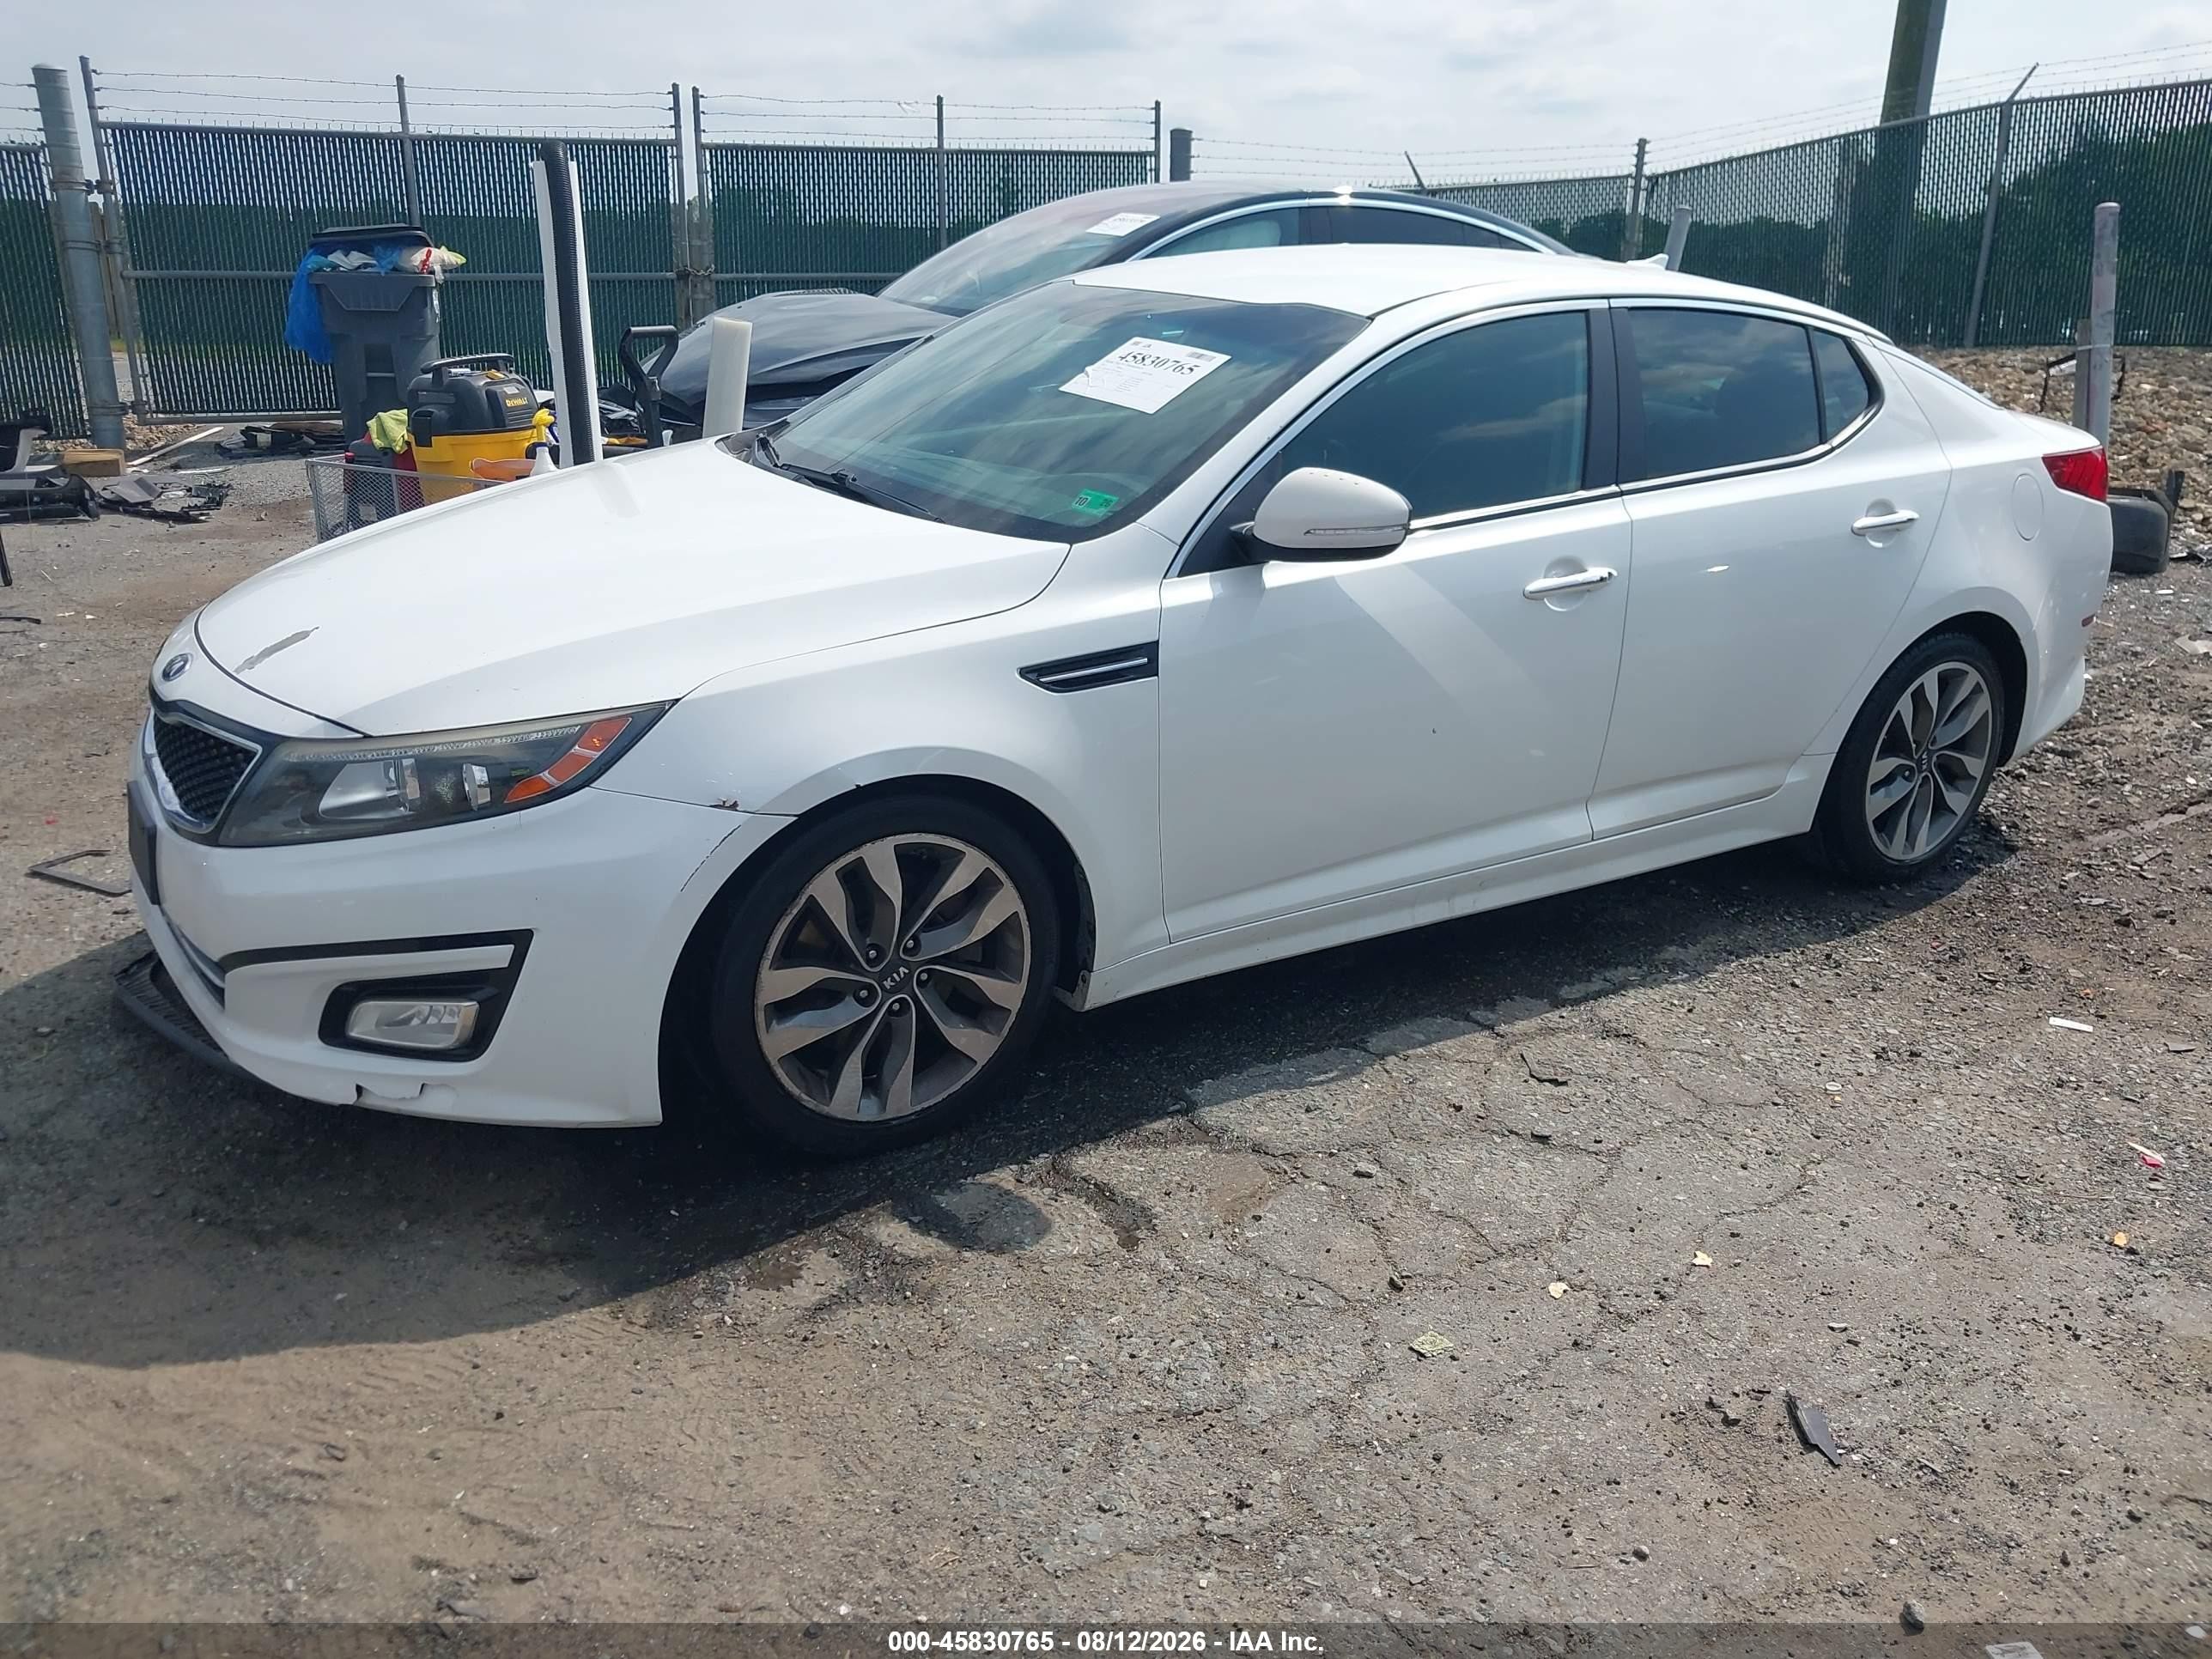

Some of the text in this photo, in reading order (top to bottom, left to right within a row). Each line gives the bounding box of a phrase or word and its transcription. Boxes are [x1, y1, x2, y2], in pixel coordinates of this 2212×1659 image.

[1118, 351, 1202, 375] 45830765
[1074, 496, 1089, 507] 10
[883, 966, 909, 990] KIA
